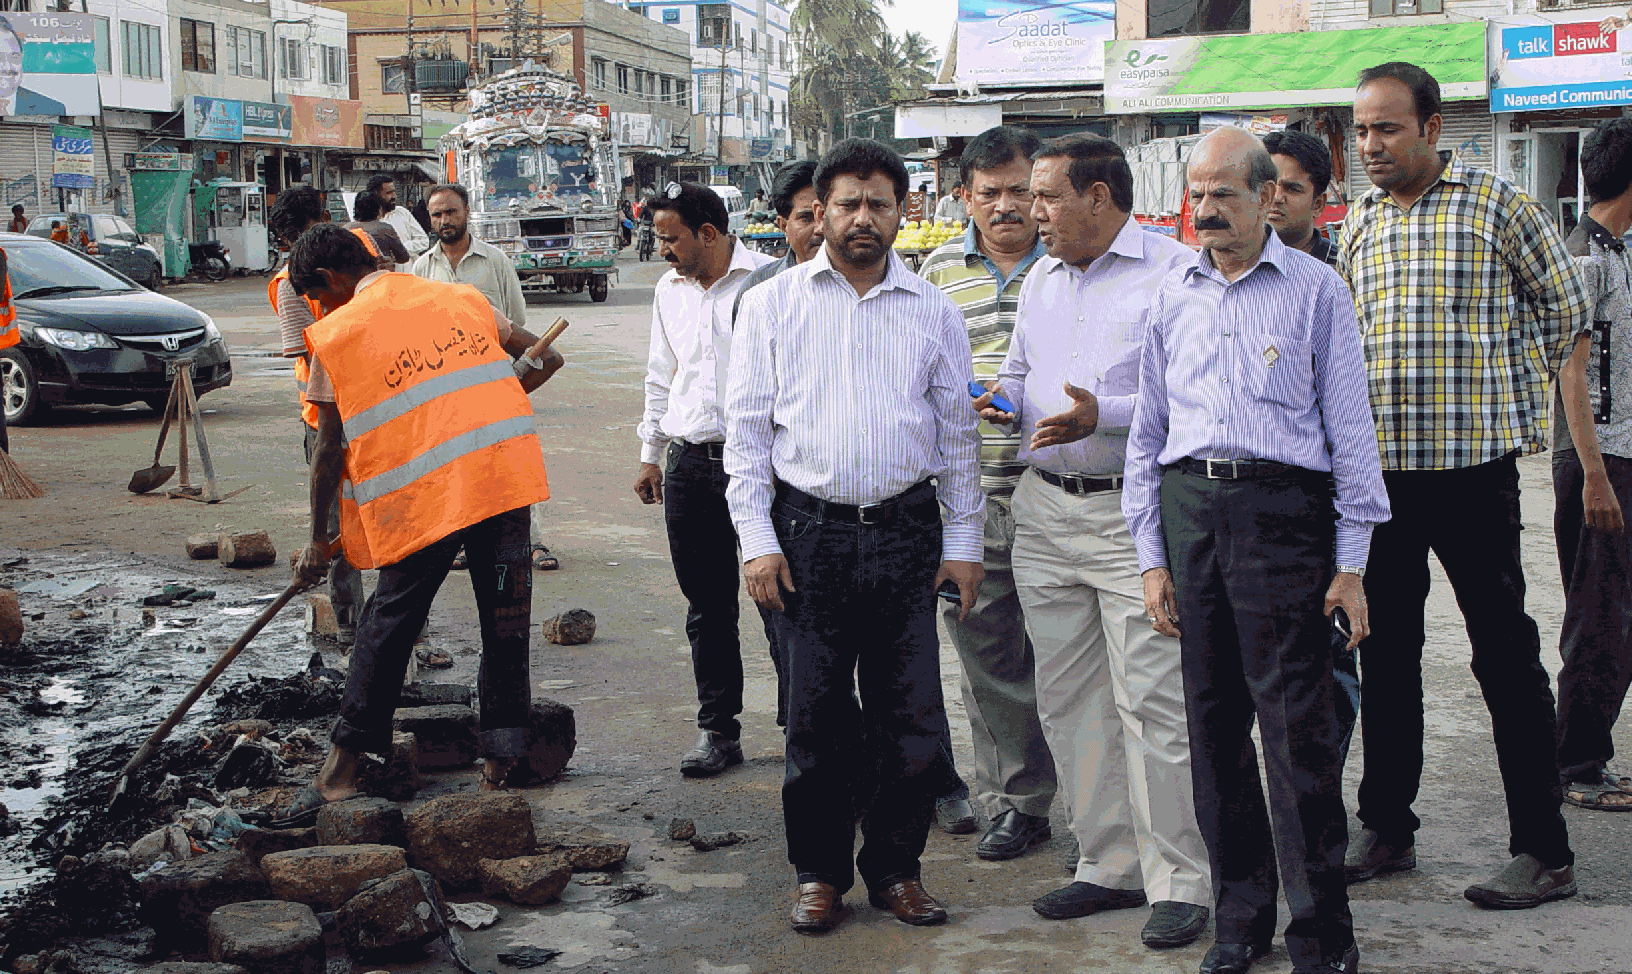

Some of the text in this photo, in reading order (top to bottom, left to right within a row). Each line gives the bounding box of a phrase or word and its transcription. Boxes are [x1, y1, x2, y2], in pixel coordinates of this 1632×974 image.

[29, 17, 60, 28] 106
[1012, 37, 1086, 48] Optics & Eye Clinic
[1517, 33, 1610, 55] talk shawk
[1120, 68, 1170, 81] easypaisa
[1154, 95, 1230, 107] COMMUNICATION
[1503, 89, 1557, 107] Naveed
